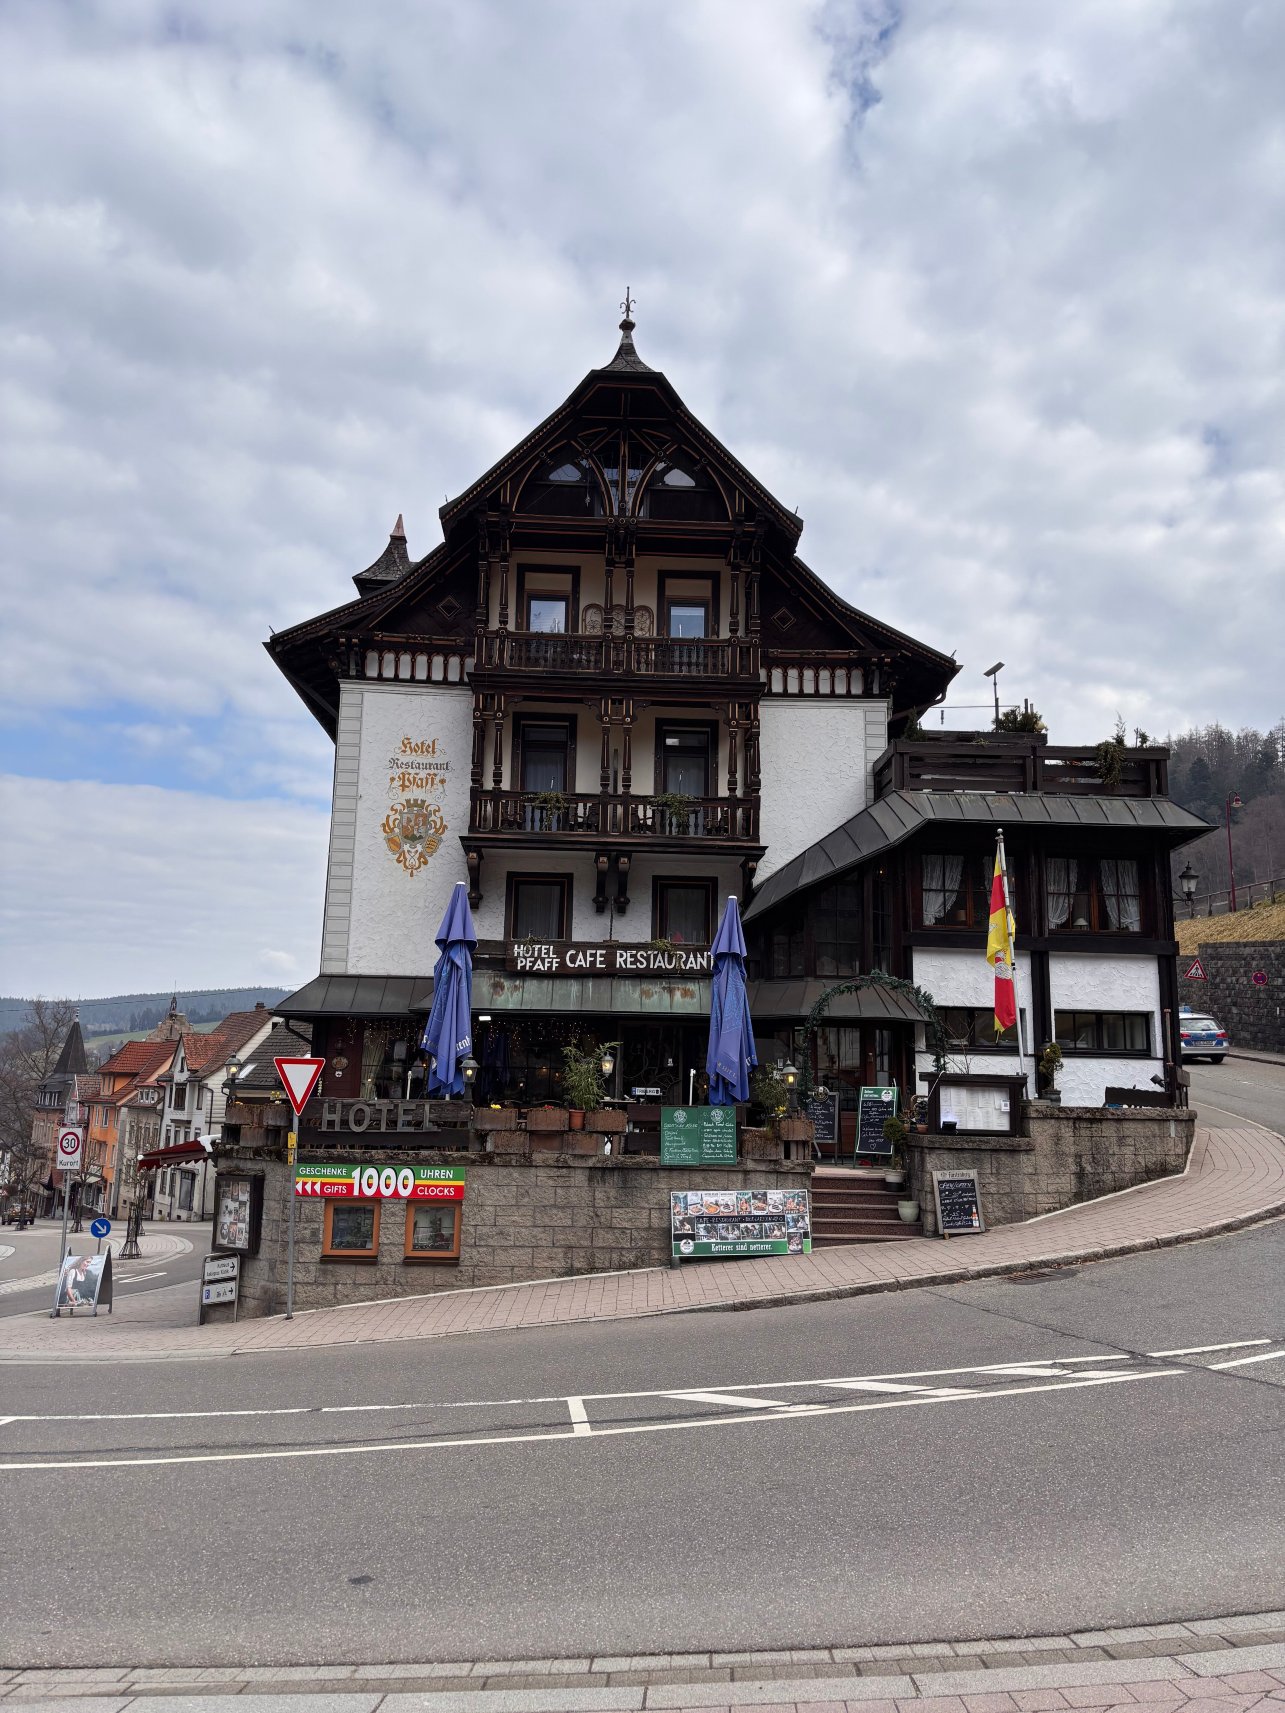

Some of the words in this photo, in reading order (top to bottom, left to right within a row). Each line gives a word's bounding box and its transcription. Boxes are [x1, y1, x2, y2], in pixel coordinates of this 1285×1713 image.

[401, 736, 438, 755] Hotel
[388, 758, 452, 771] Restaurant
[397, 771, 438, 793] Pfaff
[514, 945, 557, 958] HOTEL
[517, 958, 560, 971] PFAFF
[566, 950, 606, 968] CAFE
[321, 1101, 438, 1132] HOTEL
[64, 1137, 76, 1149] 30
[59, 1159, 79, 1167] Kurort
[299, 1167, 347, 1176] GESCHENKE
[420, 1169, 454, 1179] UHREN
[351, 1166, 415, 1197] 1000
[323, 1185, 347, 1194] GIFTS
[417, 1186, 455, 1196] CLOCKS
[735, 1242, 747, 1251] sind
